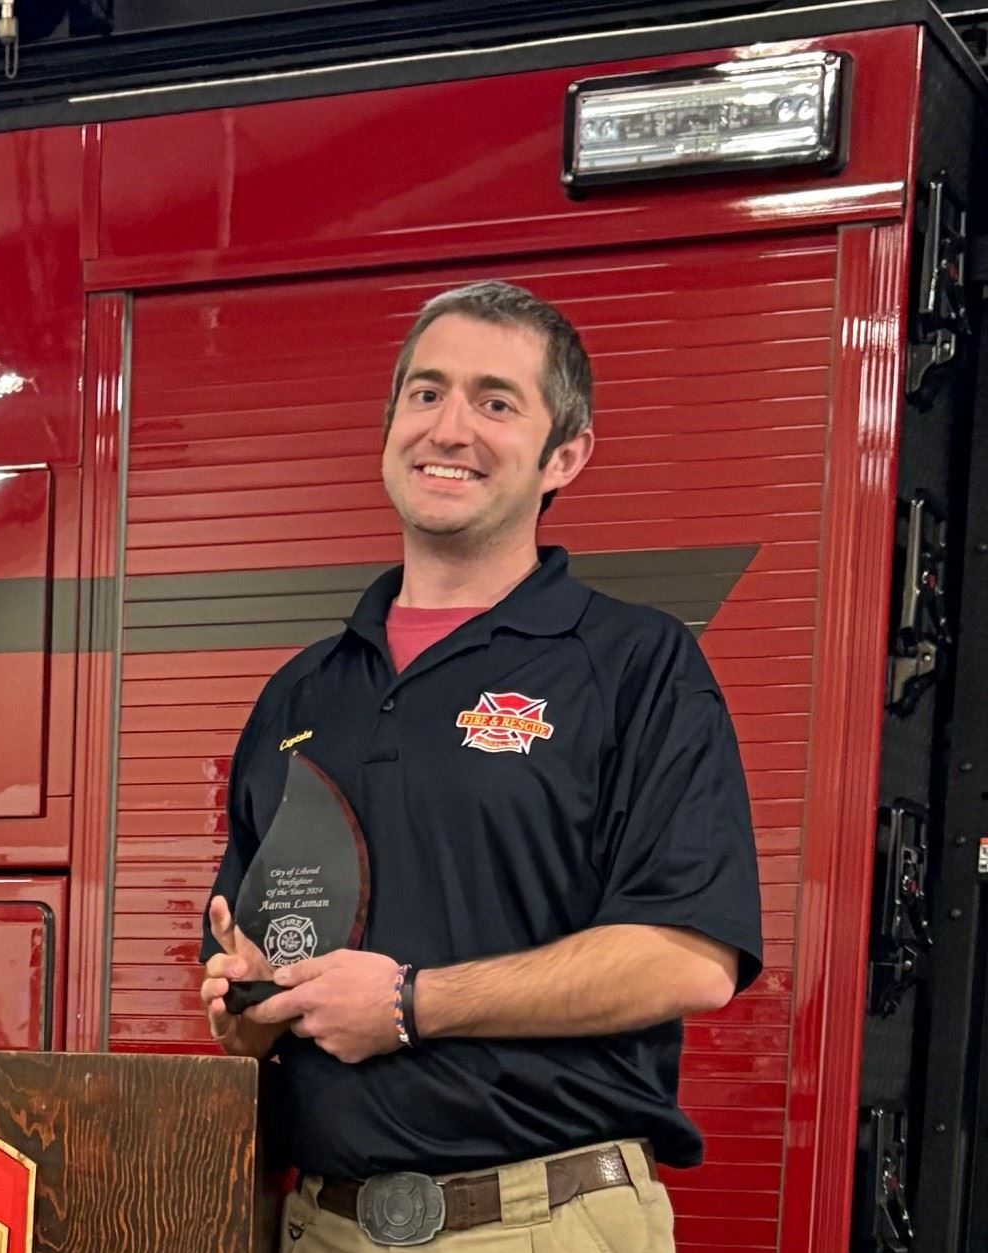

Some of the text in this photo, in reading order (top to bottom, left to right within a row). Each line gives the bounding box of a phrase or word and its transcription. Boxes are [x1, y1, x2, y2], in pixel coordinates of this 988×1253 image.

[462, 713, 489, 727] FIRE
[501, 716, 549, 736] RESCUE
[270, 866, 321, 878] City of Liberal
[258, 899, 330, 912] Aaron Luman
